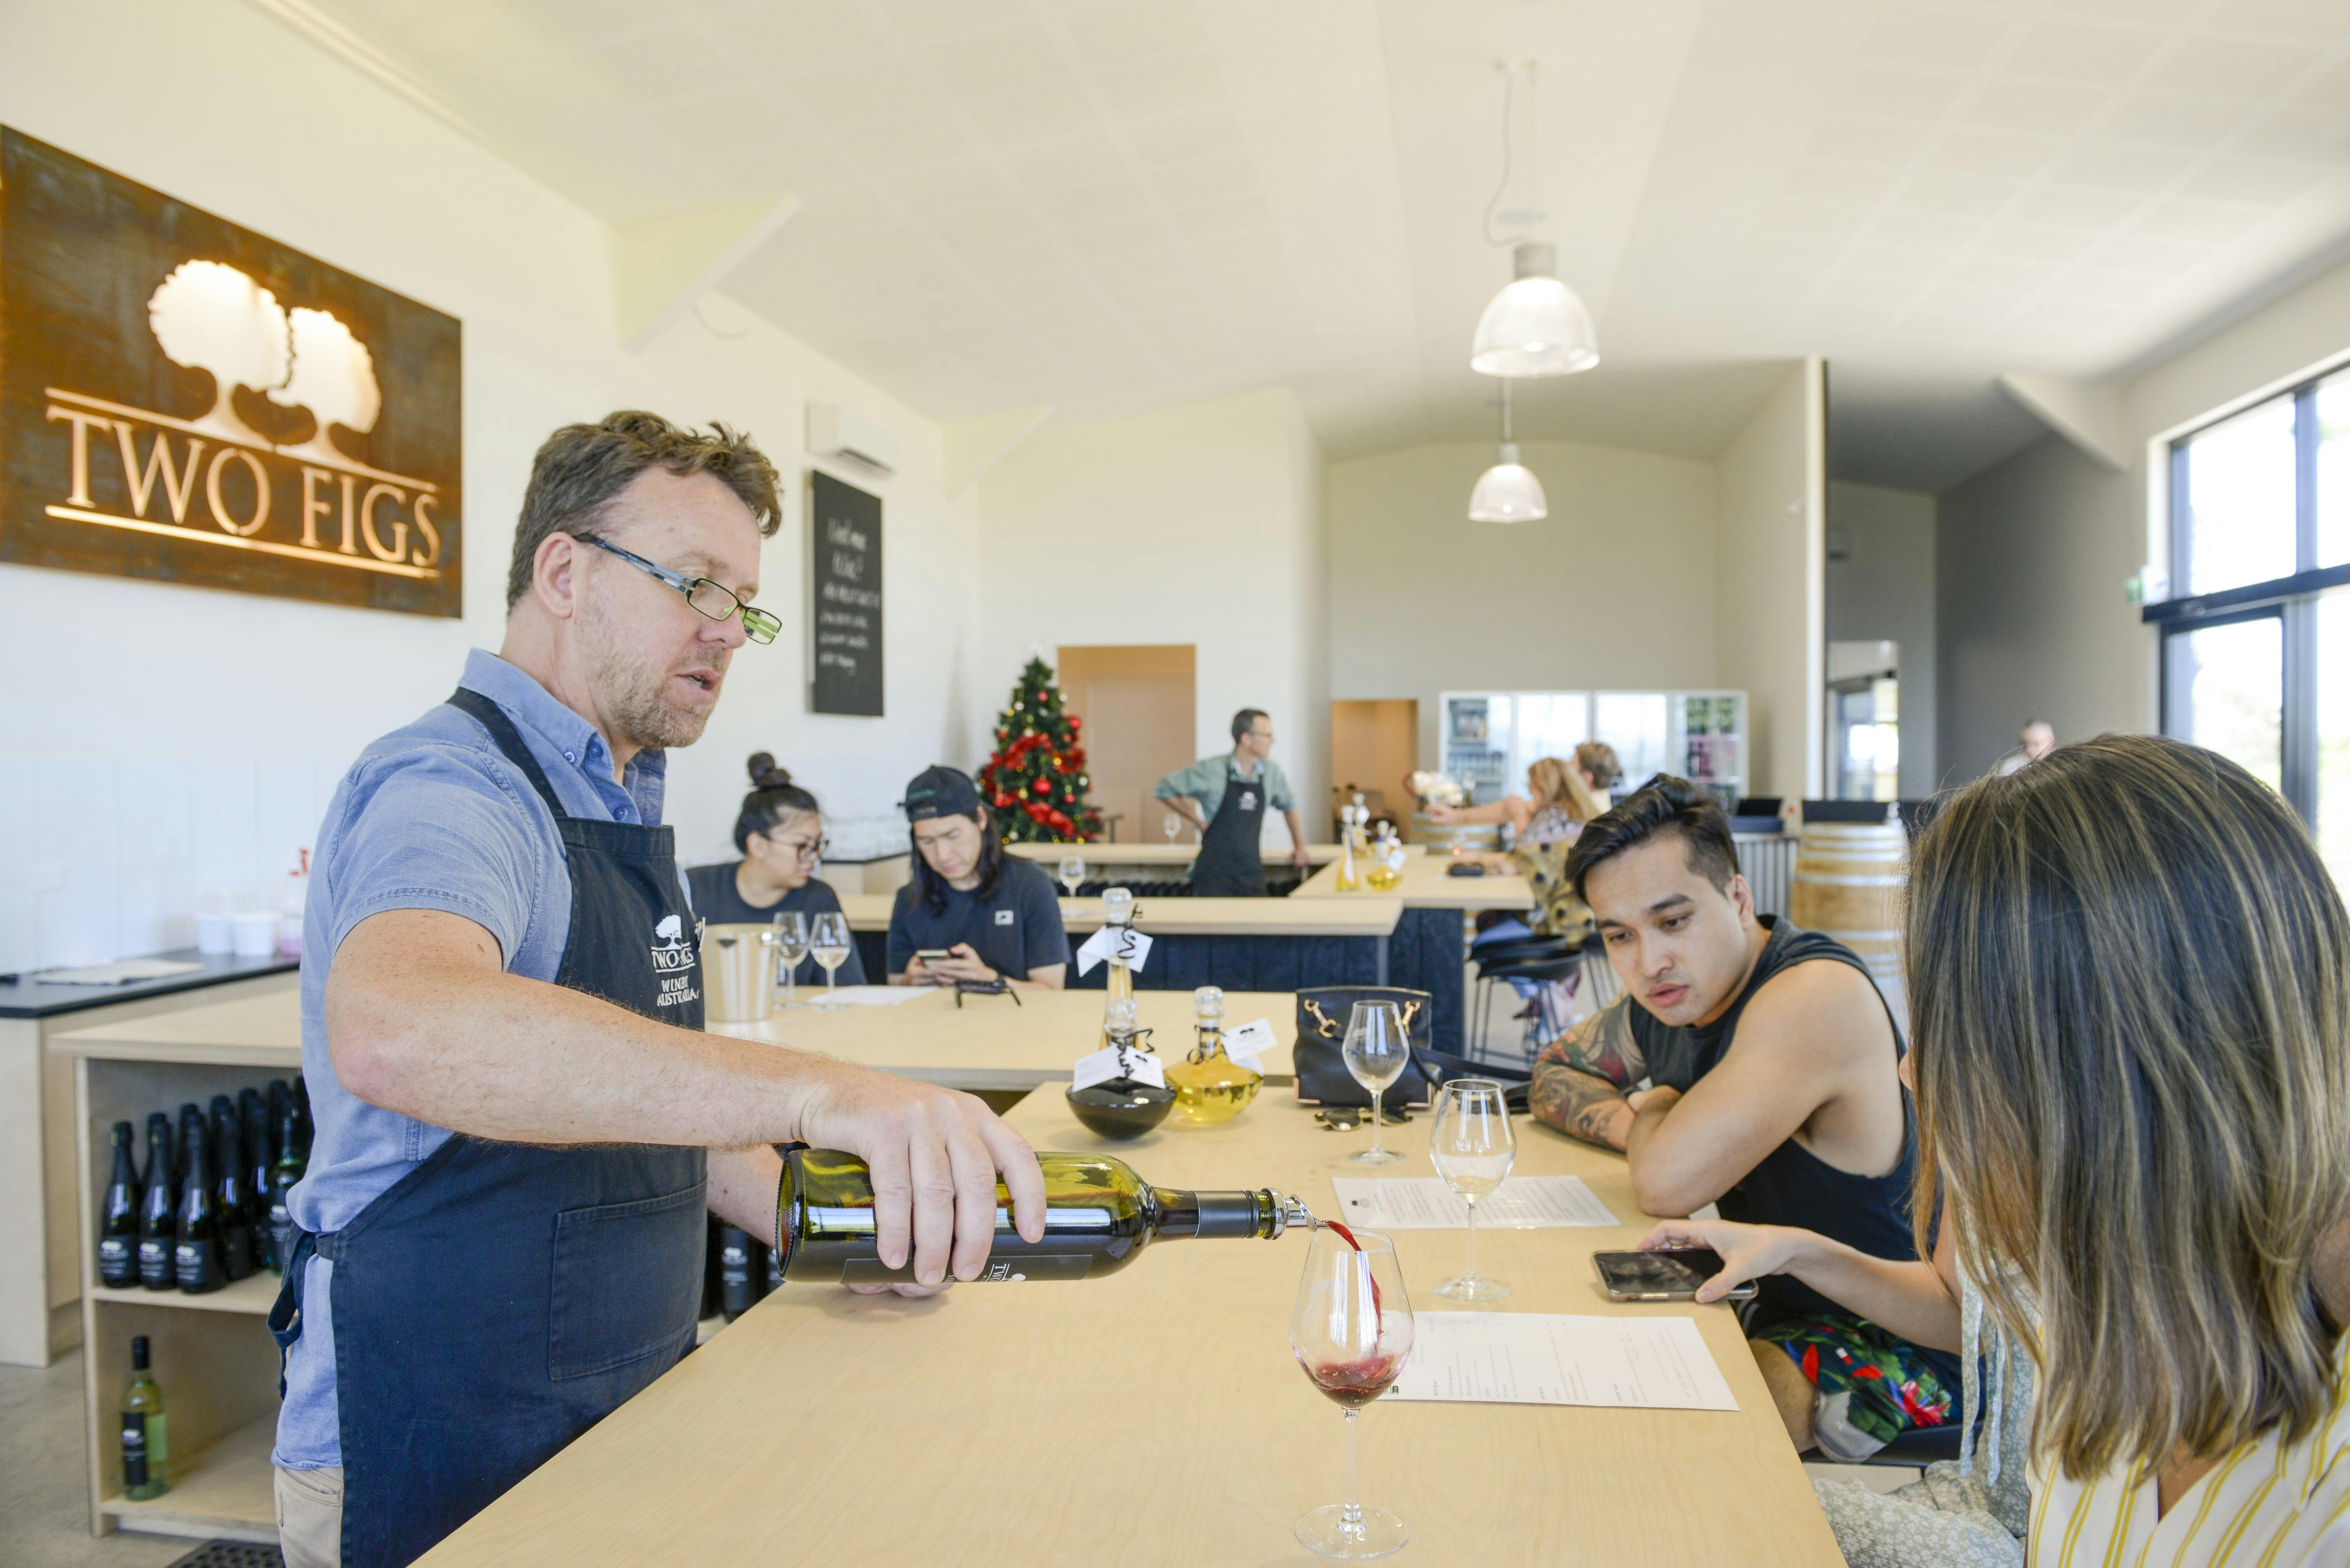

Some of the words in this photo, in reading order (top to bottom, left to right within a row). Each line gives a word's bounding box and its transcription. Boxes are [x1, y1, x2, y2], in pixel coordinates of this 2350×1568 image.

[46, 403, 271, 537] TWO
[300, 466, 441, 568] FIGS
[651, 950, 679, 968] TWO
[989, 1263, 1007, 1282] TWO
